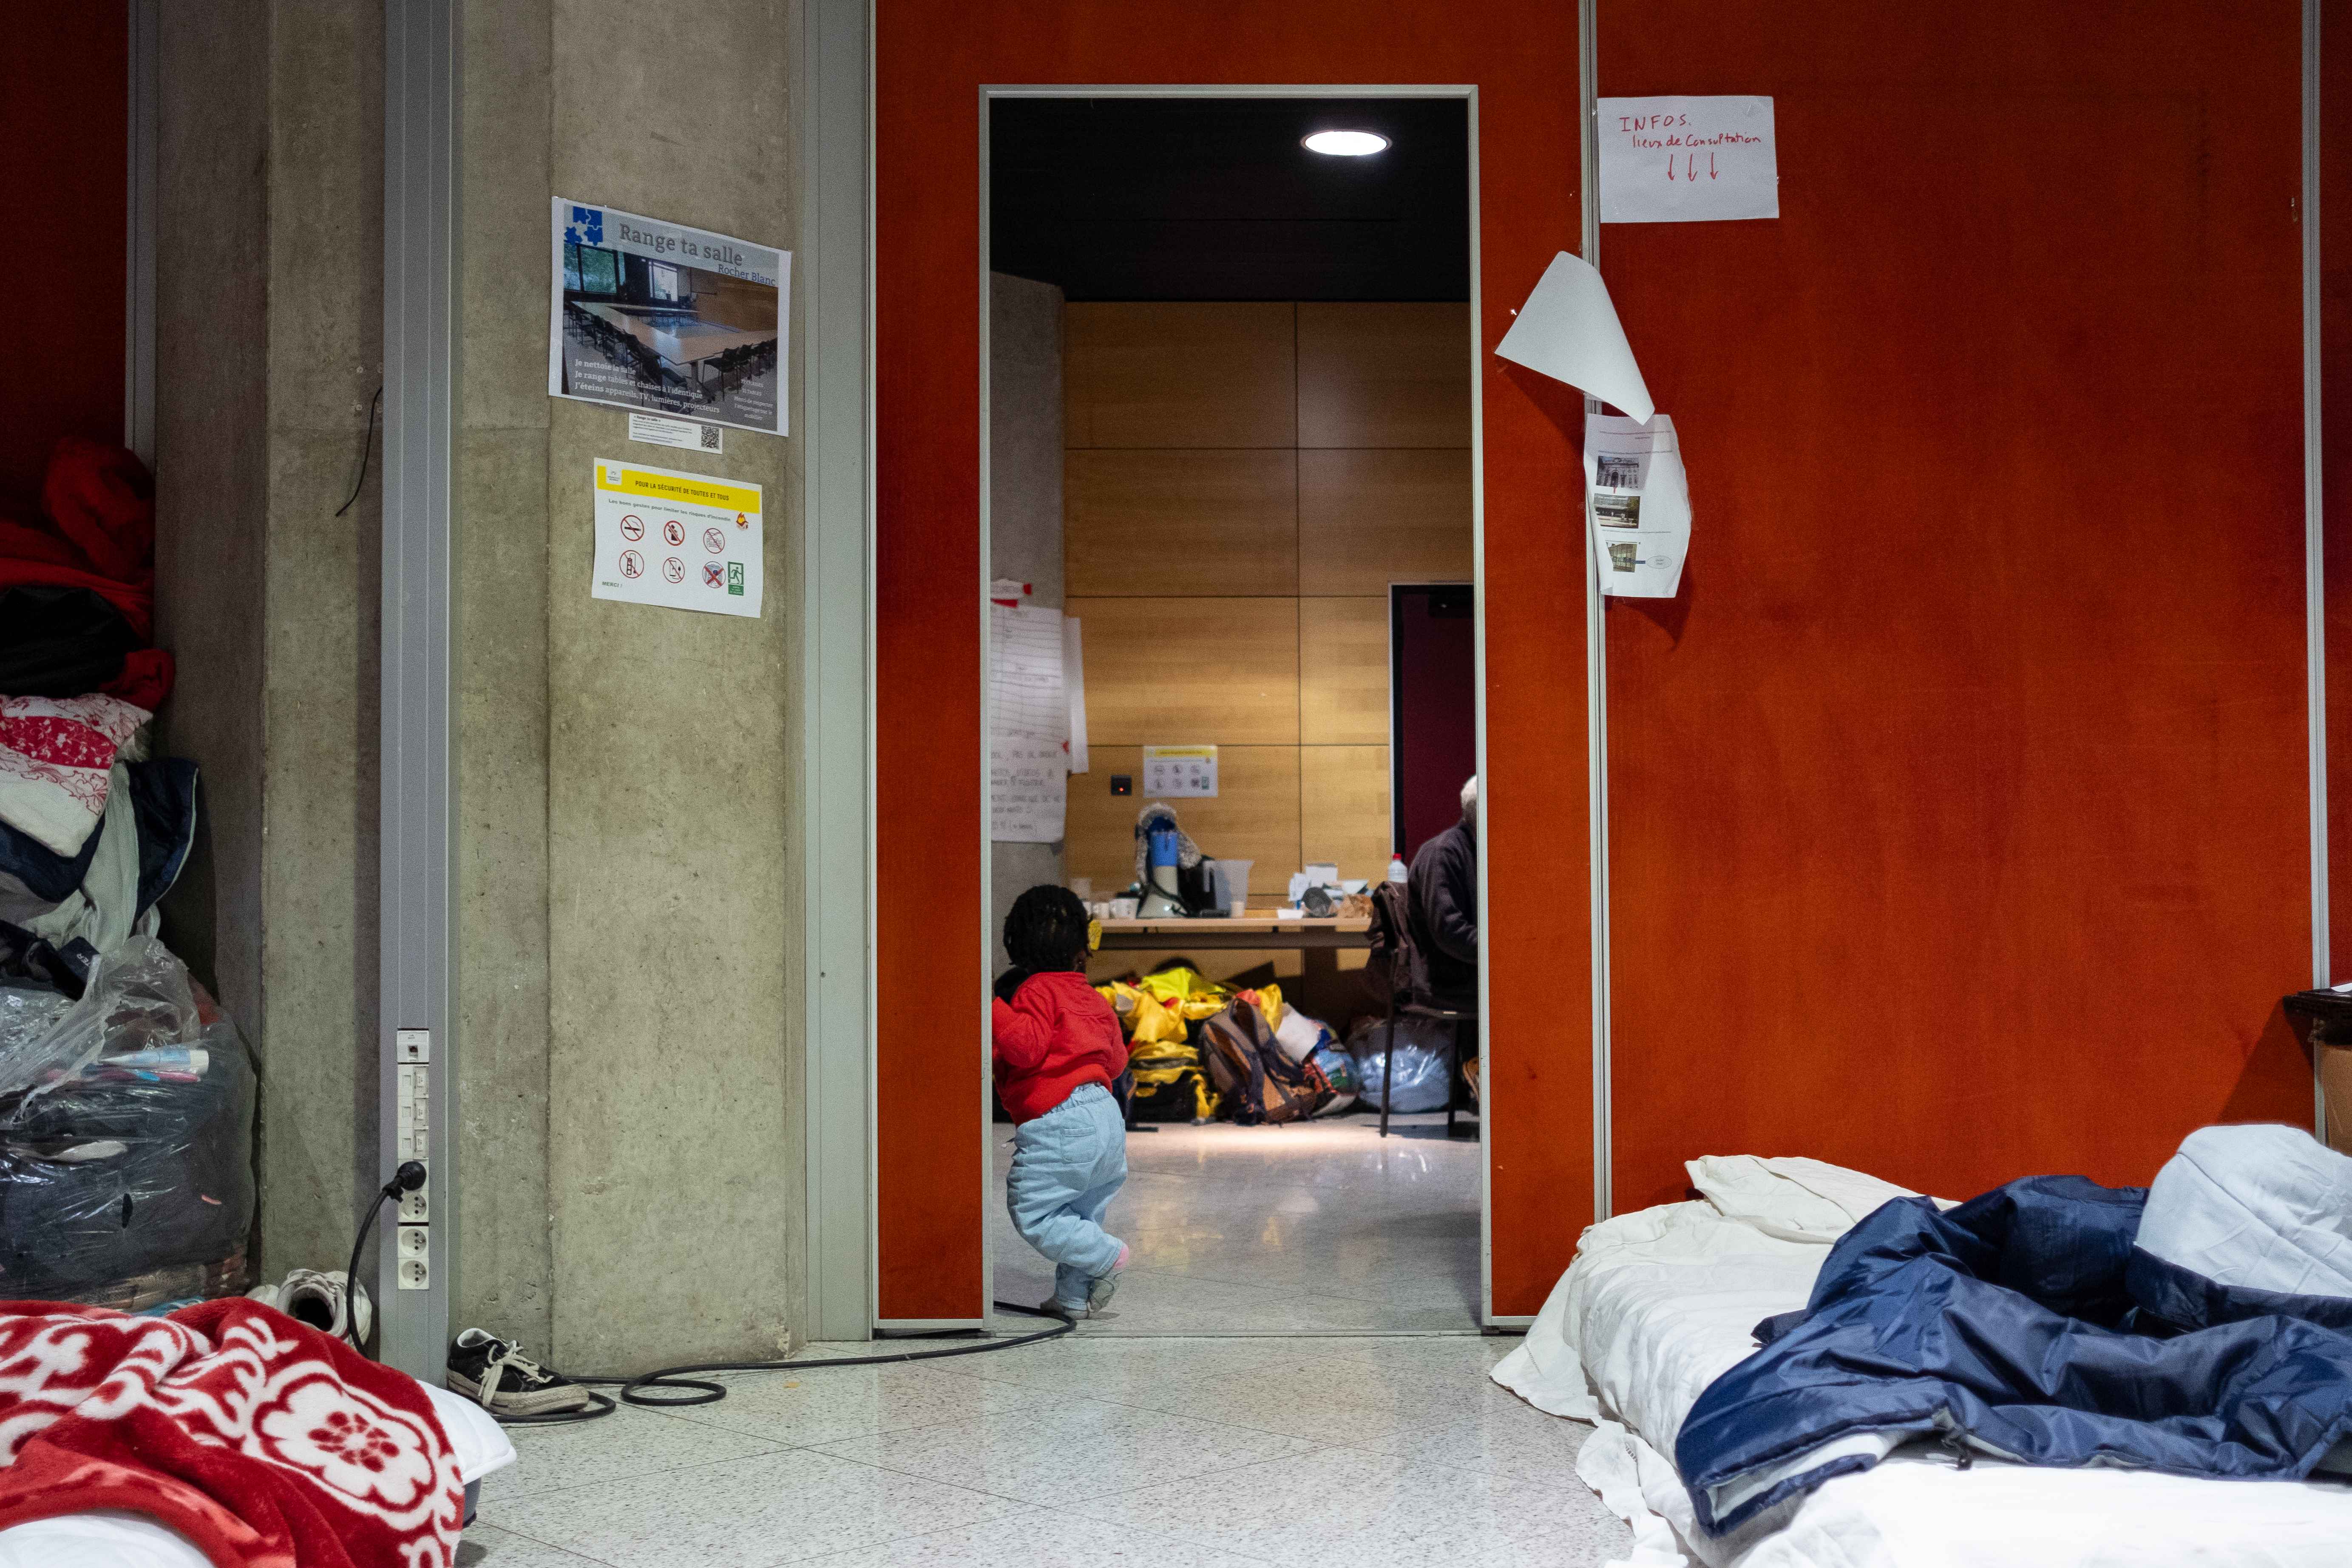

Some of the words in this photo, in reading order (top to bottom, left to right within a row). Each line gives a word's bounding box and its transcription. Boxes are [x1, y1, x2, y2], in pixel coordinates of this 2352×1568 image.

[1666, 134, 1682, 147] de
[1685, 132, 1761, 147] Consultation
[619, 224, 675, 253] Range
[681, 238, 698, 256] ta
[704, 246, 743, 267] salle
[718, 264, 749, 280] Rocher
[751, 272, 776, 286] Blanc
[584, 361, 612, 370] nettoie
[613, 364, 619, 372] la
[620, 365, 636, 375] salle
[574, 381, 604, 392] J'éteins
[639, 392, 650, 402] TV,
[651, 394, 682, 407] lumières,
[683, 402, 720, 413] projecteurs
[584, 373, 607, 382] range
[608, 375, 628, 385] tables
[637, 381, 661, 391] chaises
[667, 385, 703, 399] l'identique
[658, 483, 682, 493] SÉCURITÉ
[690, 489, 709, 498] TOUTES
